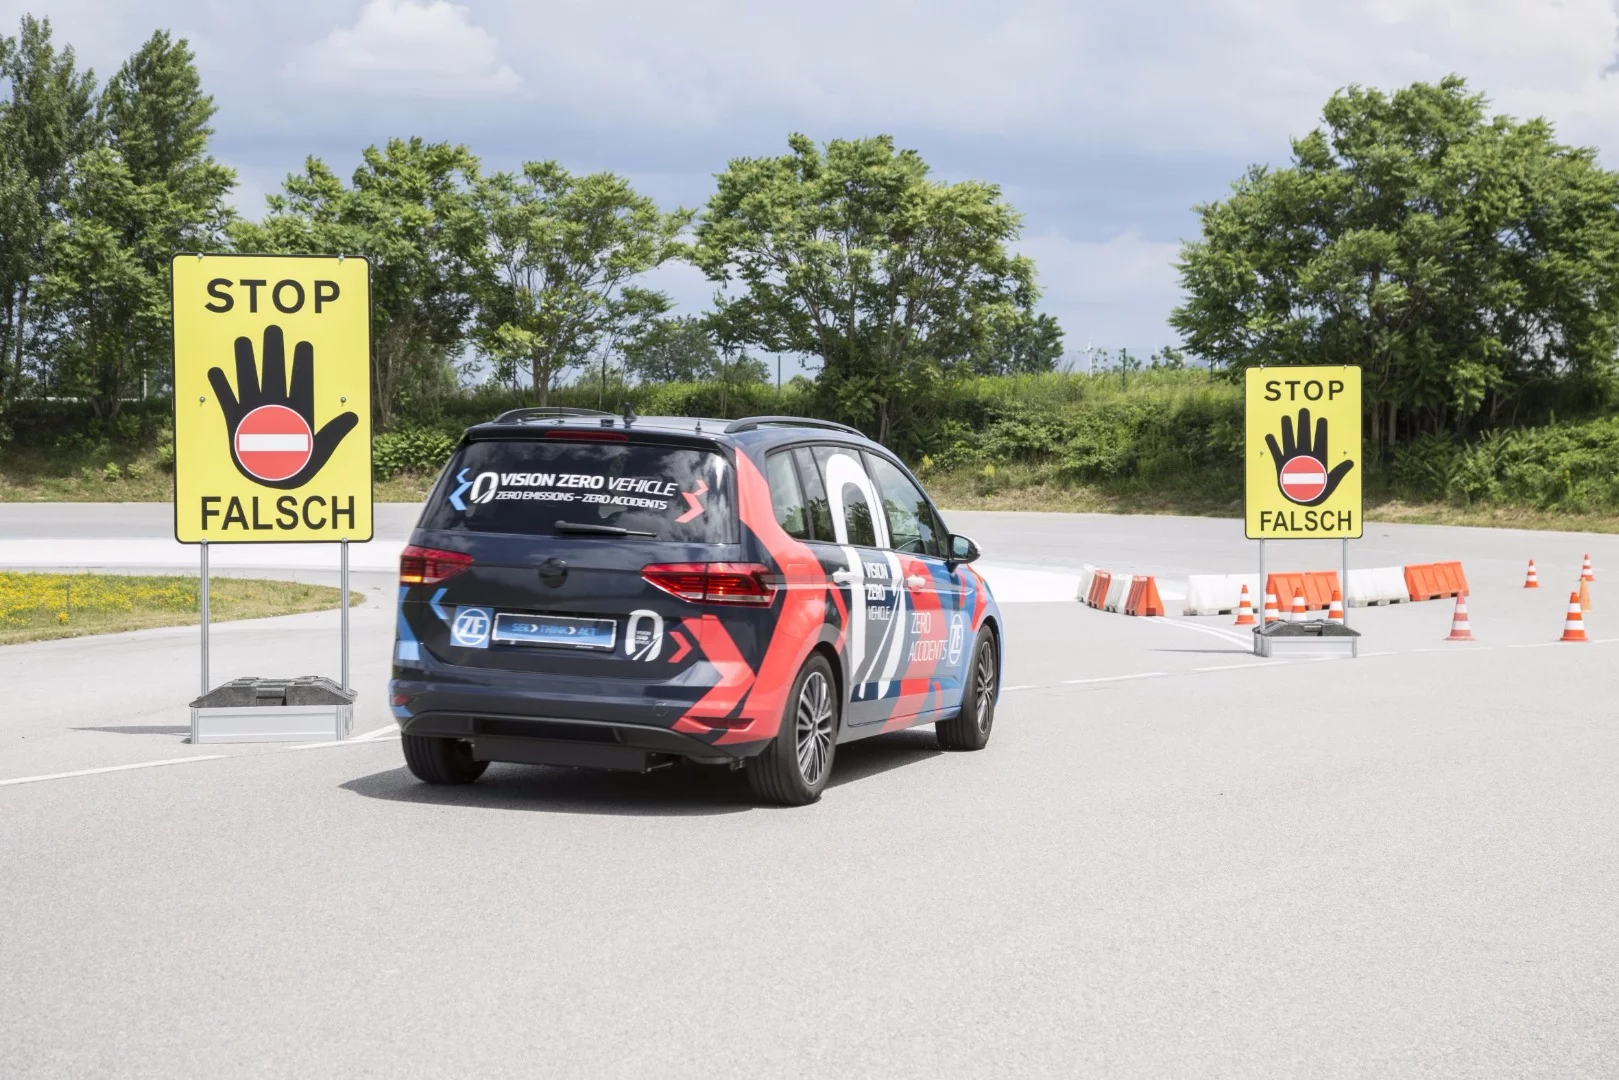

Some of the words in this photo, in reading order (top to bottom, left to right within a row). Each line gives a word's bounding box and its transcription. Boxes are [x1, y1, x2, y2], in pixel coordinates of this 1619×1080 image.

[204, 278, 340, 314] STOP
[1264, 380, 1344, 401] STOP
[501, 472, 554, 487] VISION
[556, 474, 604, 489] ZERO
[608, 477, 678, 497] VEHICLE
[495, 491, 522, 500] ZERO
[522, 491, 574, 502] EMISSIONS
[582, 493, 610, 504] ZERO
[610, 495, 667, 510] ACCIDENTS
[201, 495, 355, 531] FALSCH
[1260, 510, 1352, 532] FALSCH
[864, 562, 888, 579] VISION
[866, 584, 886, 601] ZERO
[868, 606, 890, 621] VEHICLE
[911, 612, 931, 634] ZERO
[455, 613, 489, 640] ZF
[908, 640, 948, 662] ACCIDENTS
